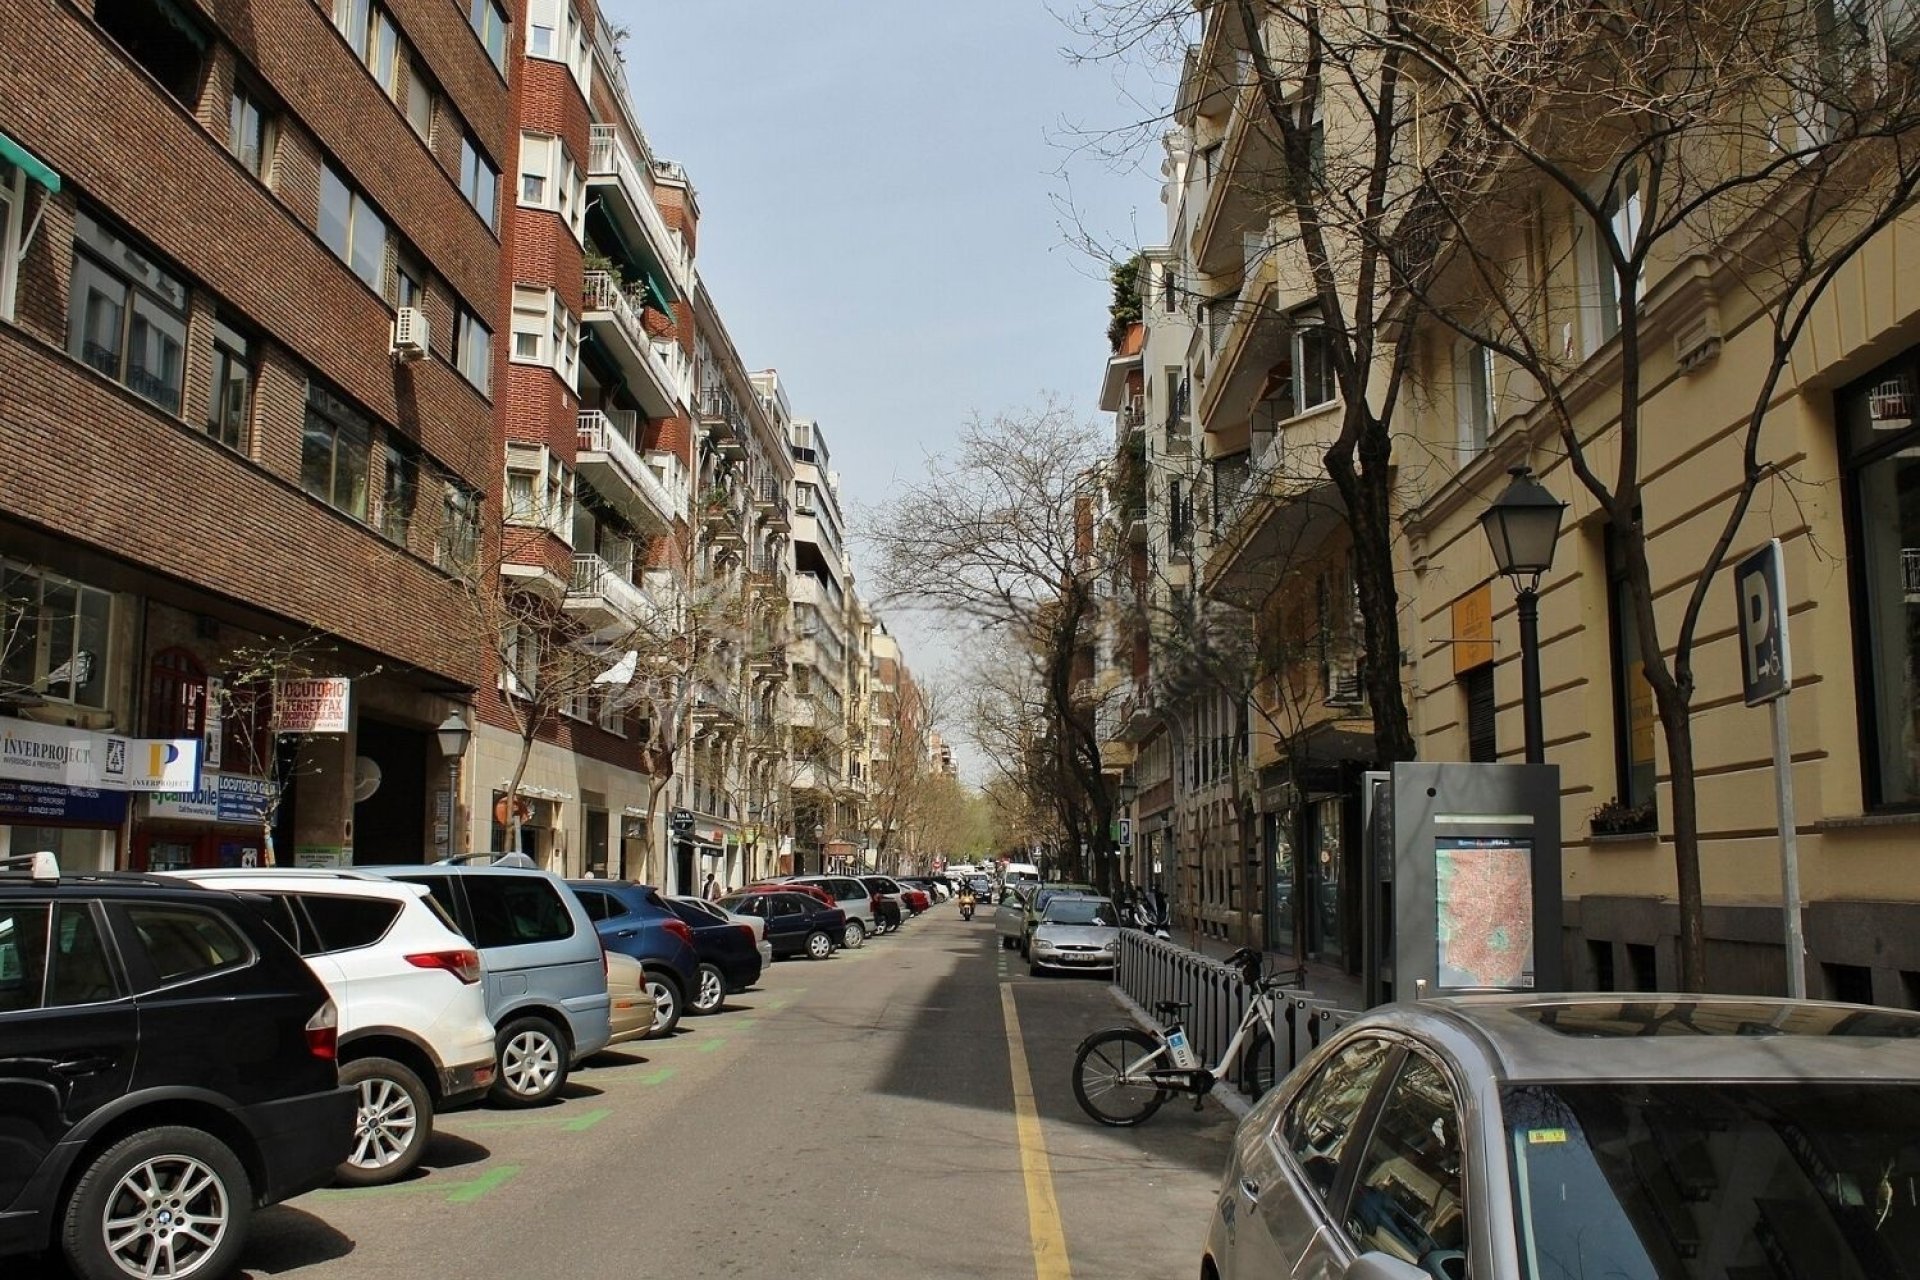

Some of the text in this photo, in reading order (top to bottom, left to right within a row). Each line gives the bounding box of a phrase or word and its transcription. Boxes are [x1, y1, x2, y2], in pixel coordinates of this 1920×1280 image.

[1742, 570, 1770, 685] P
[4, 738, 91, 763] INVERPROJECT
[132, 778, 189, 787] INVERPROJECT
[220, 776, 258, 793] LOCUTORIO
[1121, 822, 1128, 844] P
